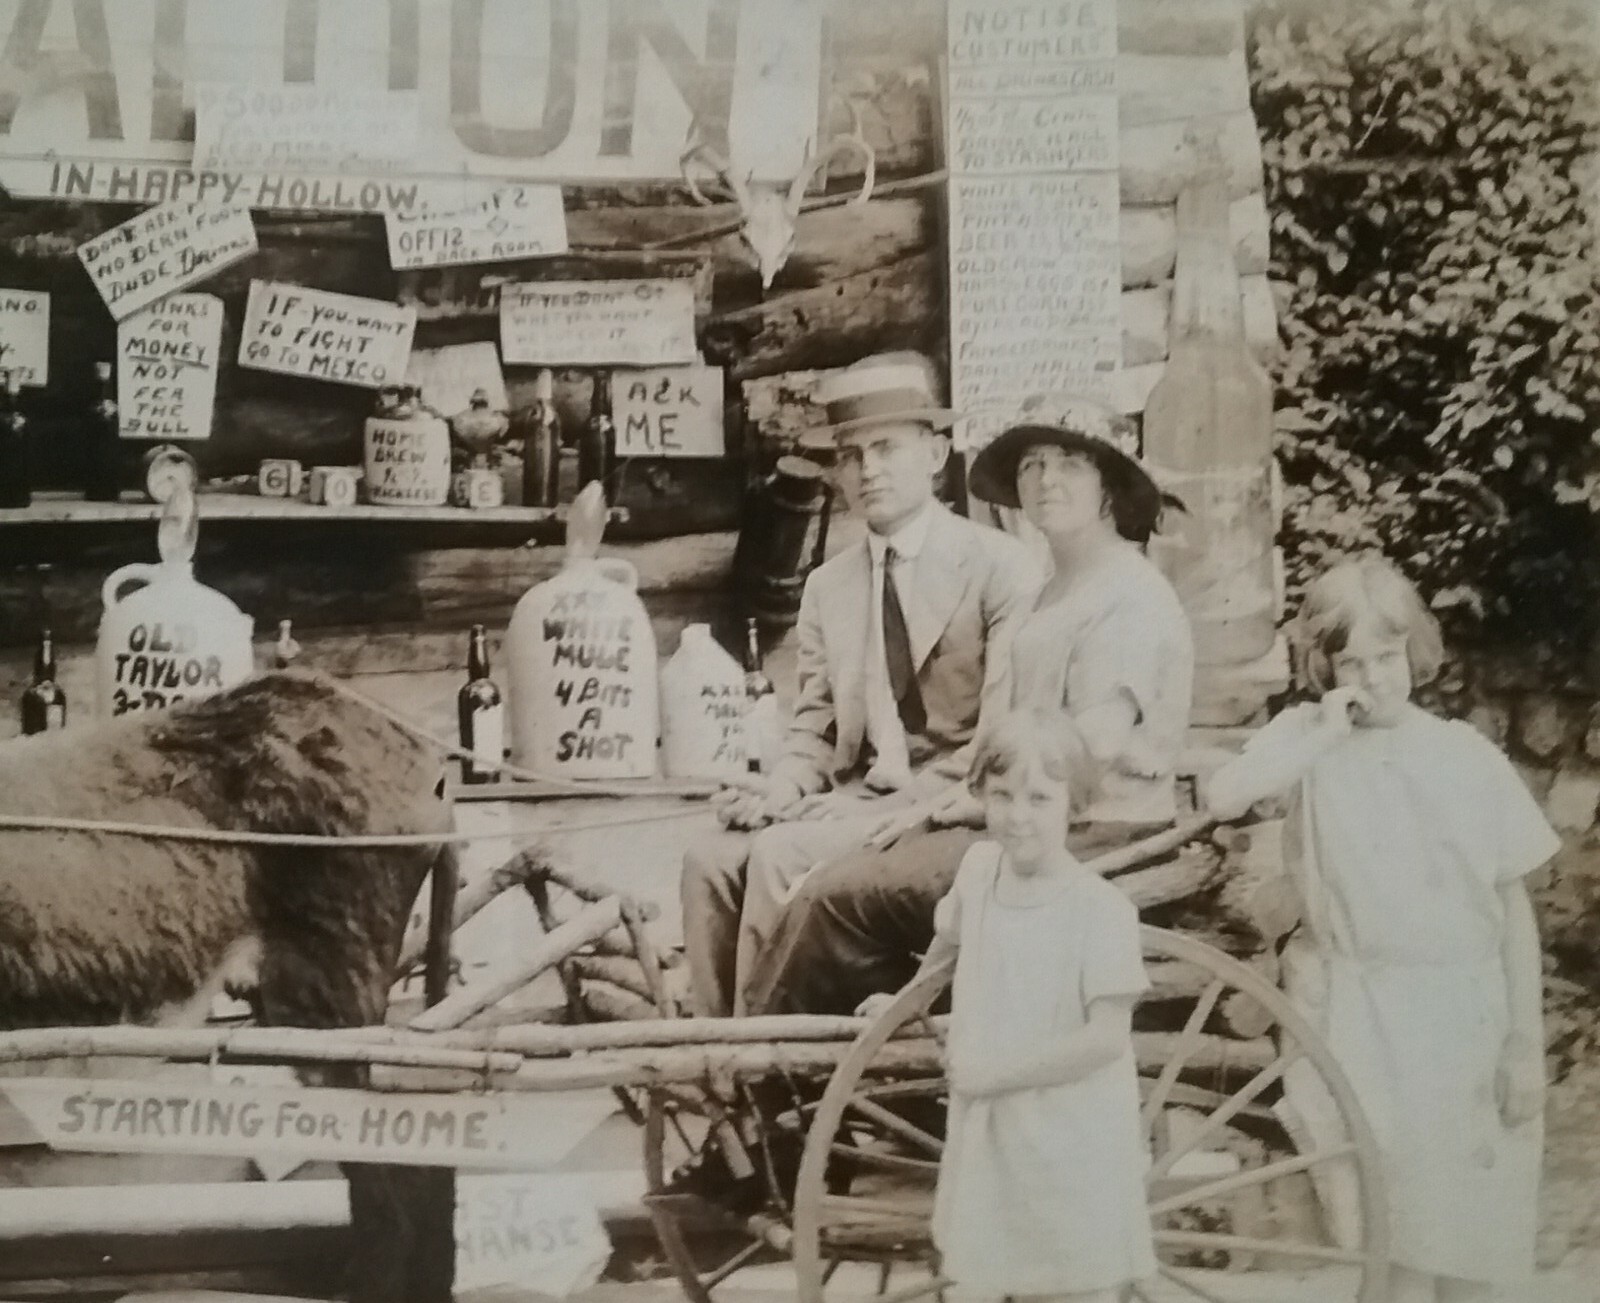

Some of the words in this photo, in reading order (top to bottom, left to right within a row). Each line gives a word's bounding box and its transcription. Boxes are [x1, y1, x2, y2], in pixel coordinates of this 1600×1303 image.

[963, 2, 1097, 36] NOTISE
[126, 336, 206, 358] MONEY
[258, 319, 283, 338] TO
[292, 325, 374, 355] FIGHT
[246, 340, 270, 361] GO
[278, 344, 300, 366] TO
[133, 364, 186, 380] NOT
[137, 403, 184, 418] THE
[625, 411, 683, 450] ME
[542, 614, 633, 642] WHITE
[114, 652, 223, 688] TAYLOR
[552, 643, 632, 673] MULE
[554, 678, 574, 706] 4
[577, 706, 602, 730] A
[555, 730, 634, 762] SHOT
[57, 1094, 264, 1138] STARTING
